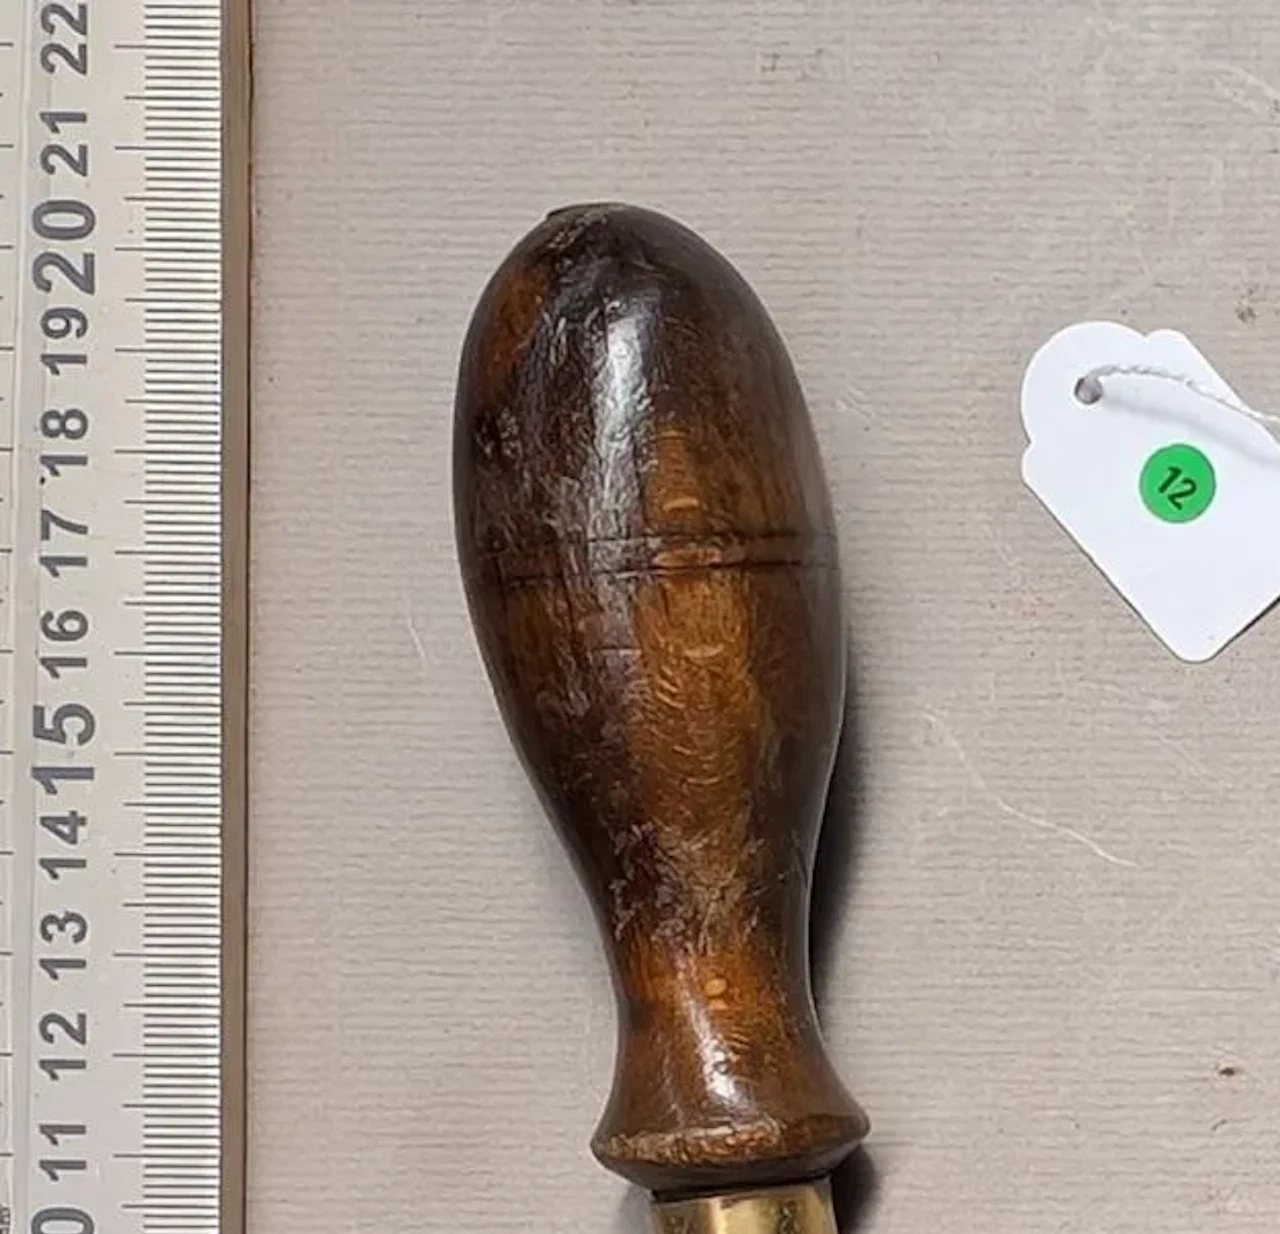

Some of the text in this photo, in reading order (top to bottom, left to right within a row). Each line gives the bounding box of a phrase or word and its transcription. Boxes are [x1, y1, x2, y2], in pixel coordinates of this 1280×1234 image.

[40, 3, 88, 76] 22
[39, 112, 88, 177] 21
[32, 200, 96, 295] 20
[40, 307, 88, 376] 19
[39, 409, 88, 477] 18
[1157, 466, 1197, 510] 12
[39, 509, 88, 578] 17
[39, 610, 88, 679] 16
[31, 704, 95, 795] 15
[39, 810, 87, 880] 14
[39, 911, 87, 980] 13
[39, 1013, 87, 1081] 12
[39, 1124, 87, 1181] 11
